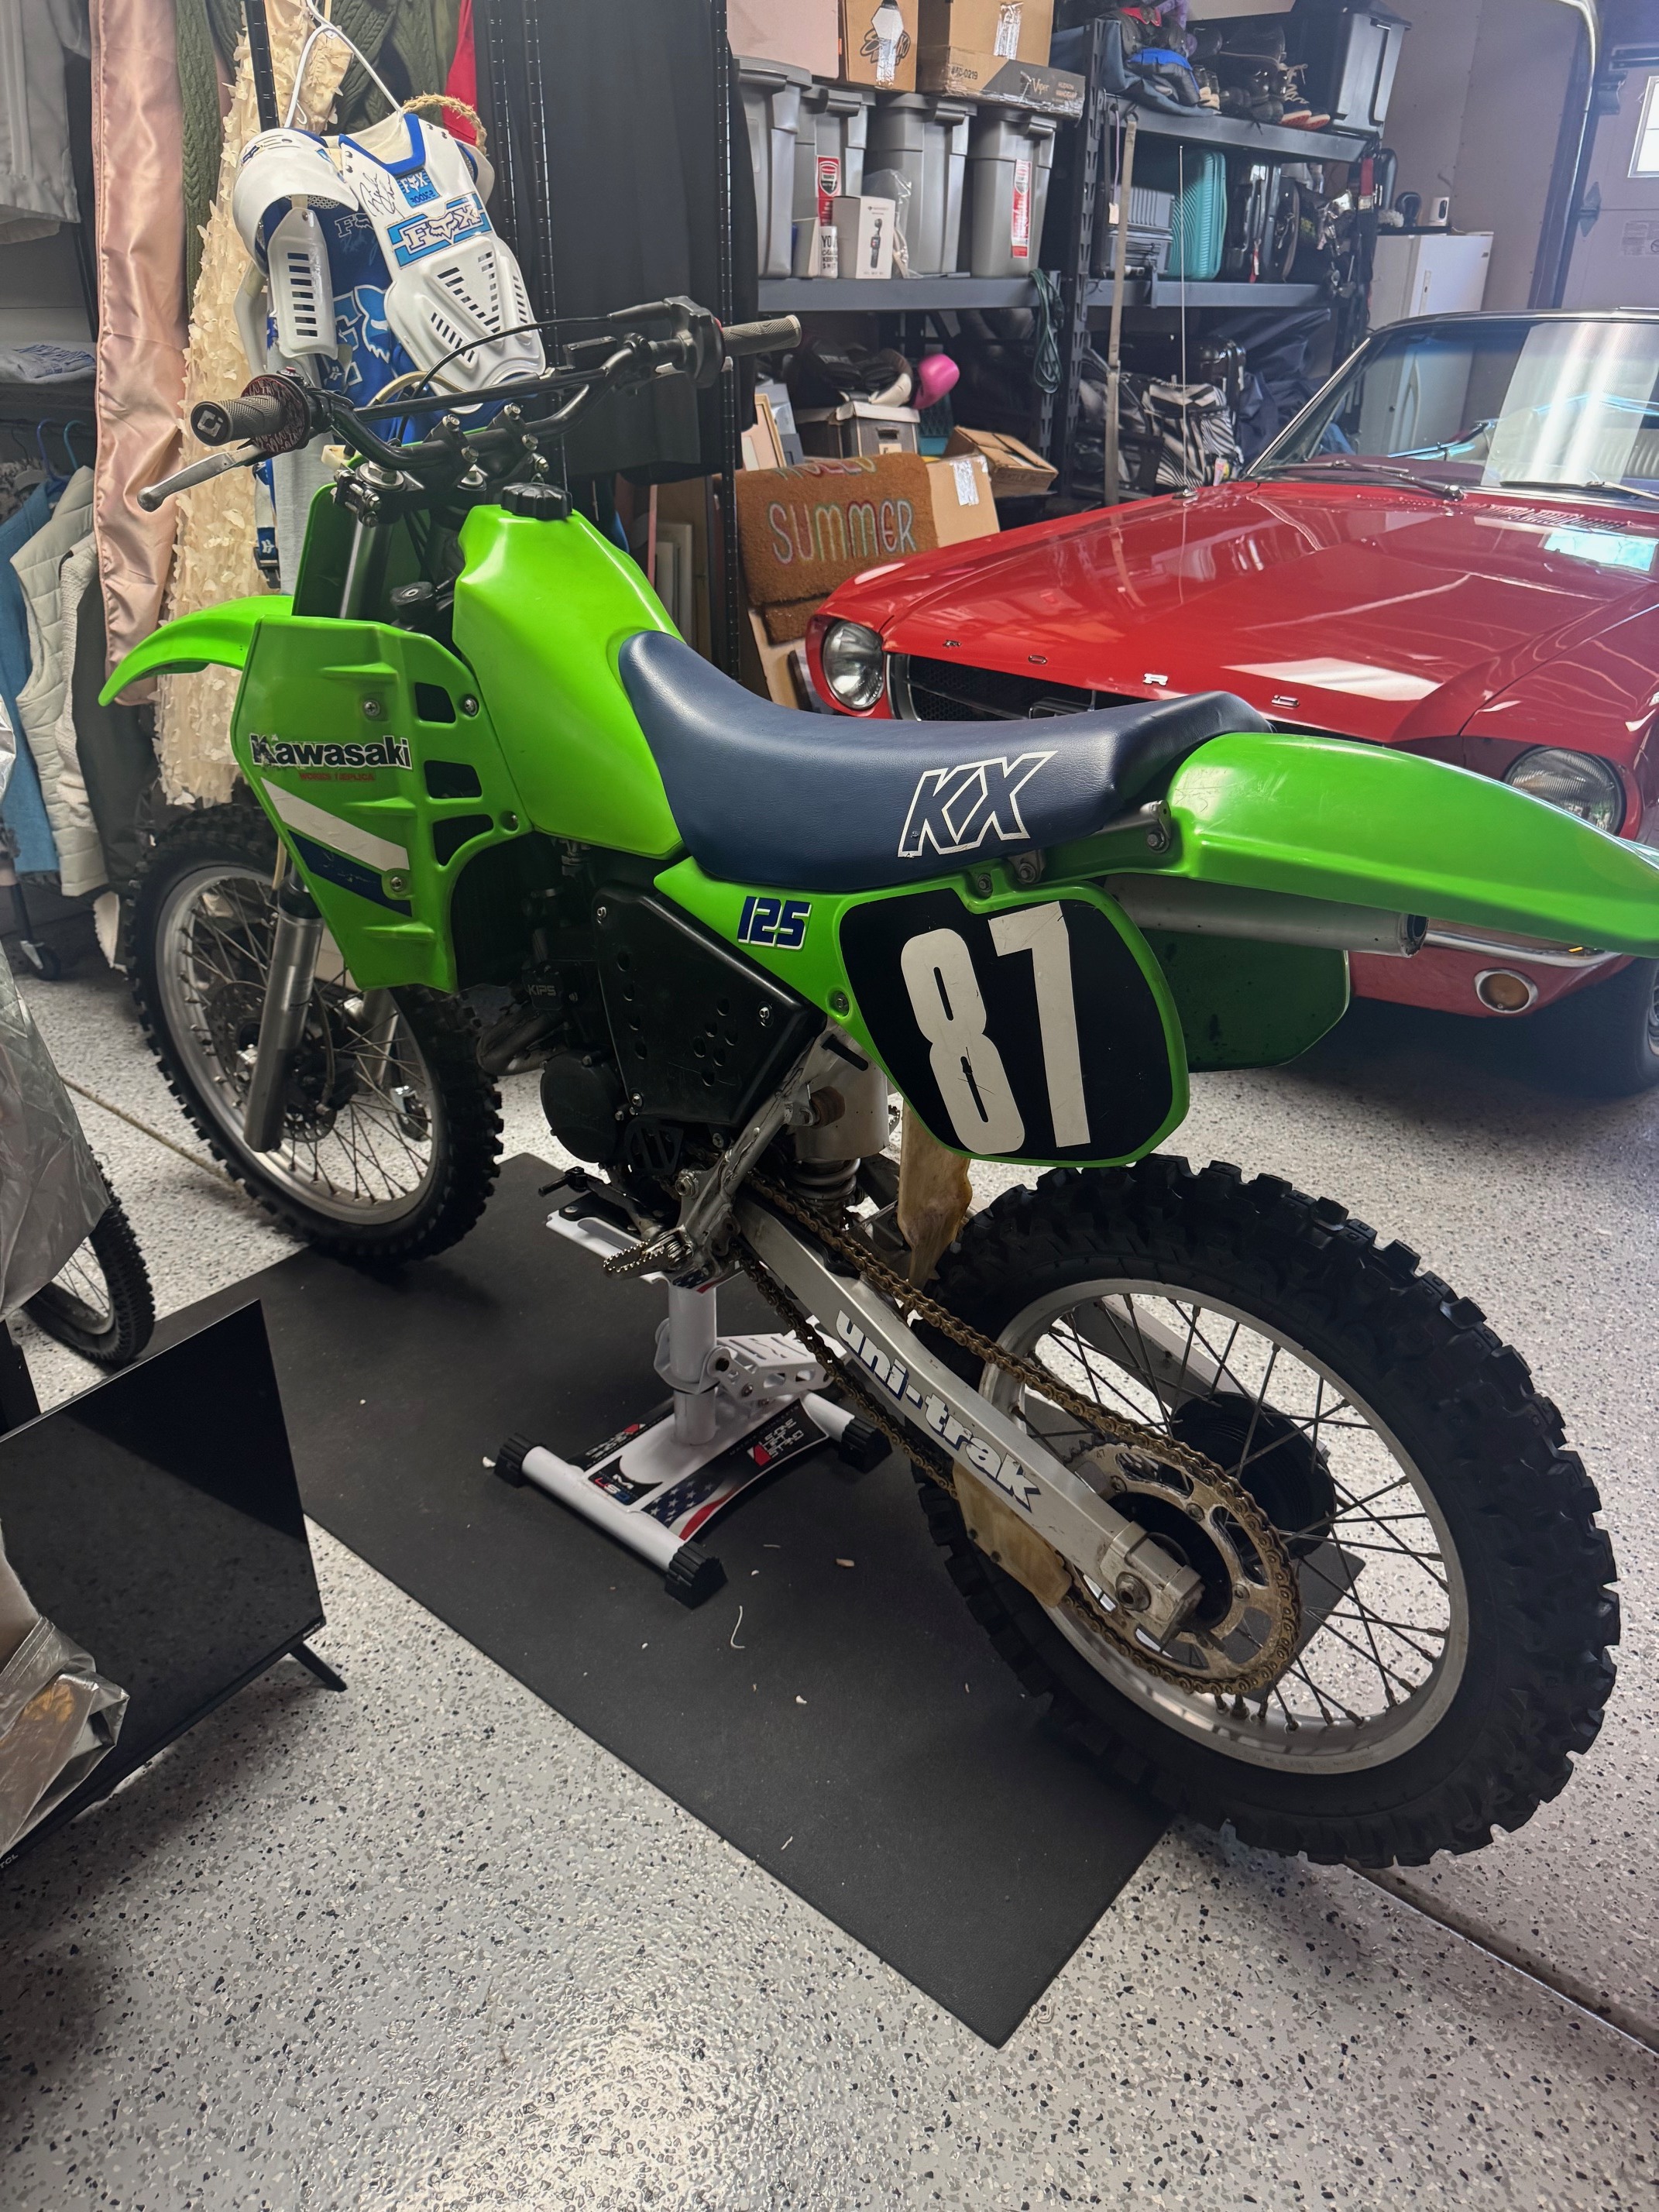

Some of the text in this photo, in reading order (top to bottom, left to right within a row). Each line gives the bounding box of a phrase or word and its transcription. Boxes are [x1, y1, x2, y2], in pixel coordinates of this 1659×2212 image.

[402, 204, 483, 253] FOX
[768, 498, 917, 565] SUMMER
[249, 733, 413, 770] Kawasaki
[897, 750, 1059, 858] KX
[737, 895, 812, 950] 125
[527, 984, 557, 996] KIPS
[901, 901, 1091, 1155] 87
[836, 1309, 1041, 1513] uni-trak
[0, 1854, 19, 1868] TCL
